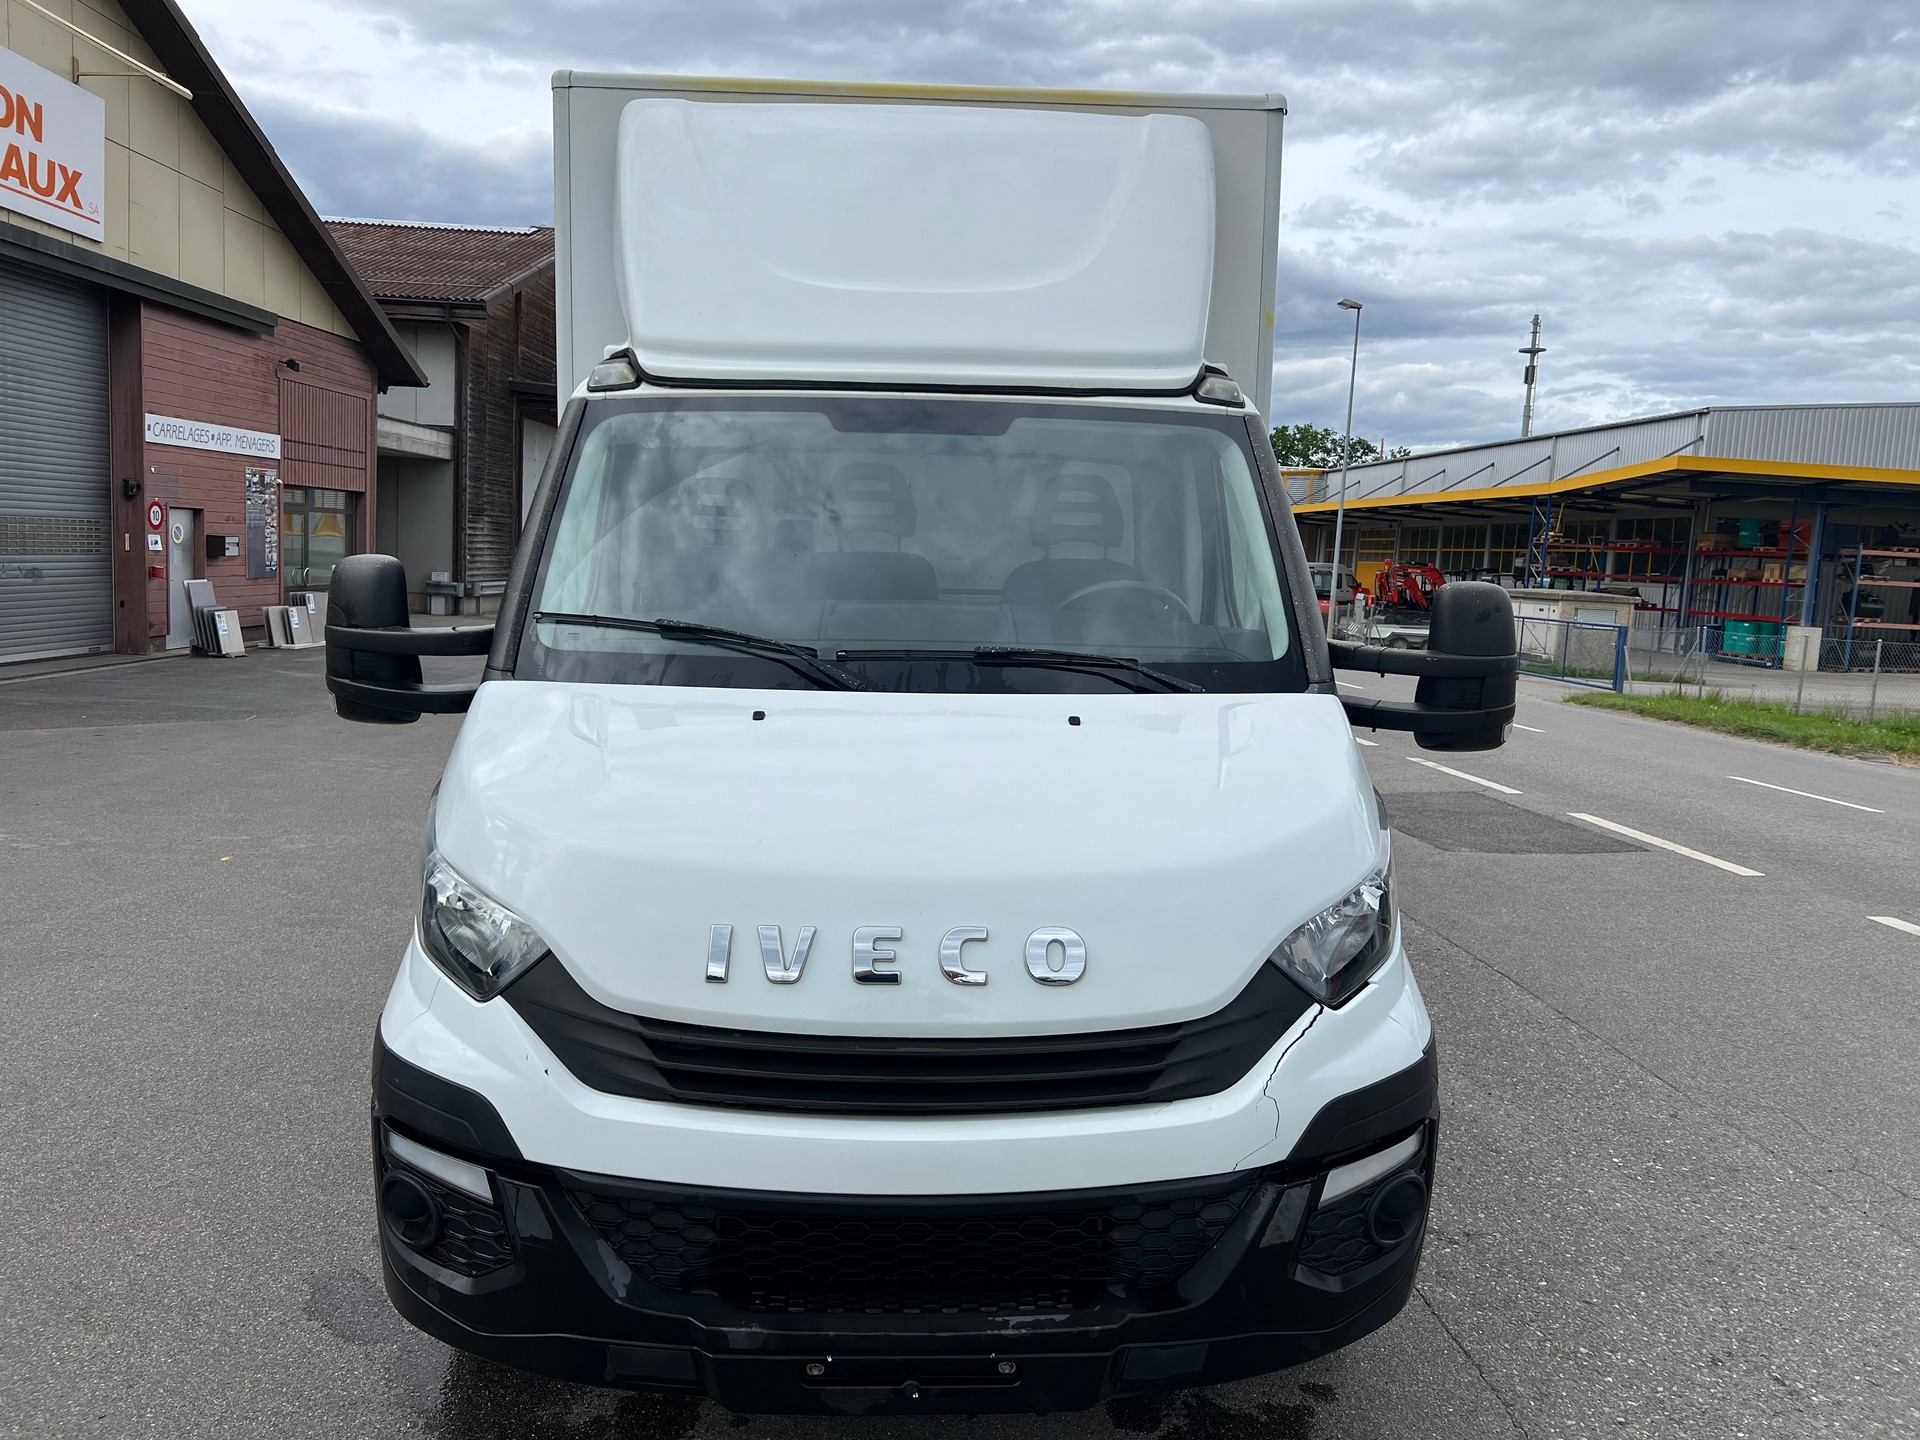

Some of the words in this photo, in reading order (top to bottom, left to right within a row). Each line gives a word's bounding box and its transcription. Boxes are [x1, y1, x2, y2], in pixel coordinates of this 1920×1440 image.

[0, 142, 84, 210] AUX
[88, 201, 100, 216] SA
[152, 422, 210, 444] CARRELAGES
[234, 432, 275, 453] MÉNAGERS
[152, 510, 160, 521] 10
[705, 923, 1088, 986] IVECO
